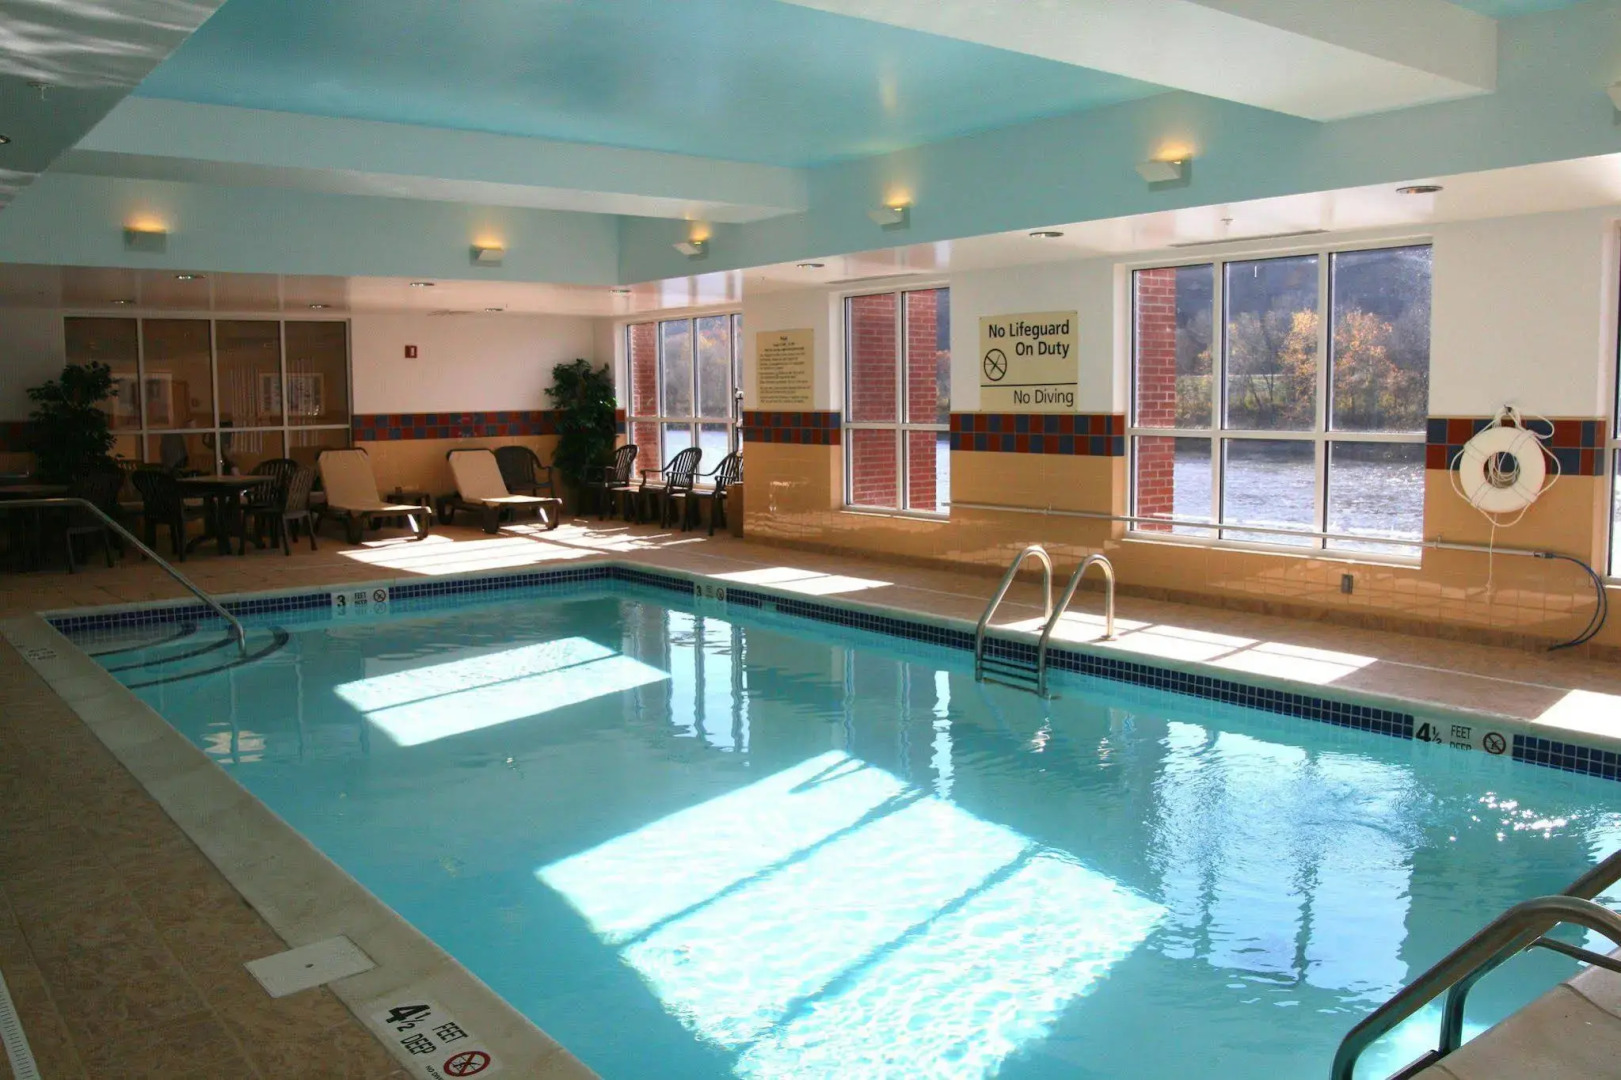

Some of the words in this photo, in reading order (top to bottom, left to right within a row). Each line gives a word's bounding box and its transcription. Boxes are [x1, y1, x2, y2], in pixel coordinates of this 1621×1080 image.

[988, 324, 1006, 338] No
[1009, 319, 1070, 340] Lifeguard
[1015, 341, 1034, 356] On
[1038, 341, 1070, 359] Duty
[1013, 390, 1031, 404] No
[1034, 388, 1074, 408] Diving
[336, 594, 346, 607] 3
[1450, 724, 1472, 740] FEET
[432, 1021, 469, 1044] FEET
[400, 1033, 437, 1055] DEEP
